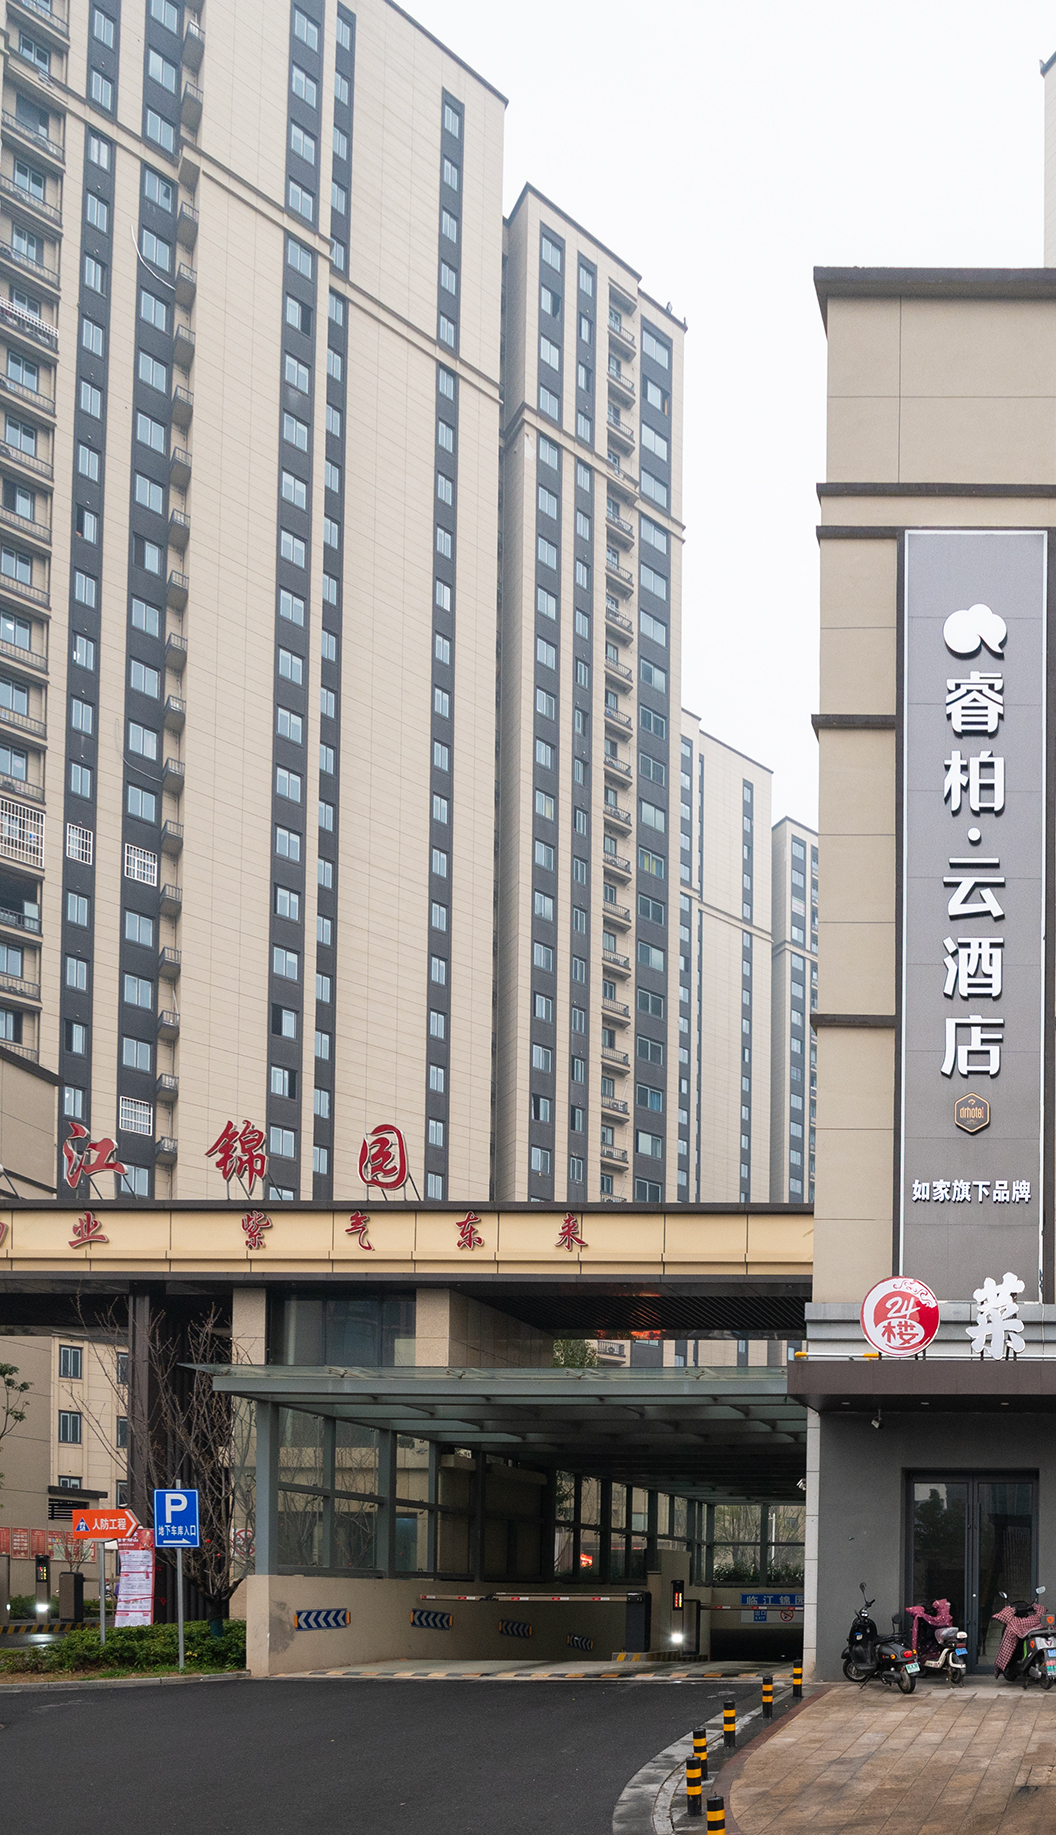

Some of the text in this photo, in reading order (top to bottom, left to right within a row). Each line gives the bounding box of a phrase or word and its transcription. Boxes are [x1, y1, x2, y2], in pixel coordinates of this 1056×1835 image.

[941, 670, 1006, 1078] 睿柏·云酒店
[62, 1119, 409, 1194] 江锦园
[911, 1179, 1032, 1203] 如家旗下品牌
[241, 1210, 588, 1251] 紫气东来
[885, 1296, 921, 1320] 24
[881, 1320, 920, 1346] 楼
[165, 1493, 188, 1524] P
[92, 1518, 127, 1531] 人防工程
[158, 1525, 197, 1536] 地下车库入口
